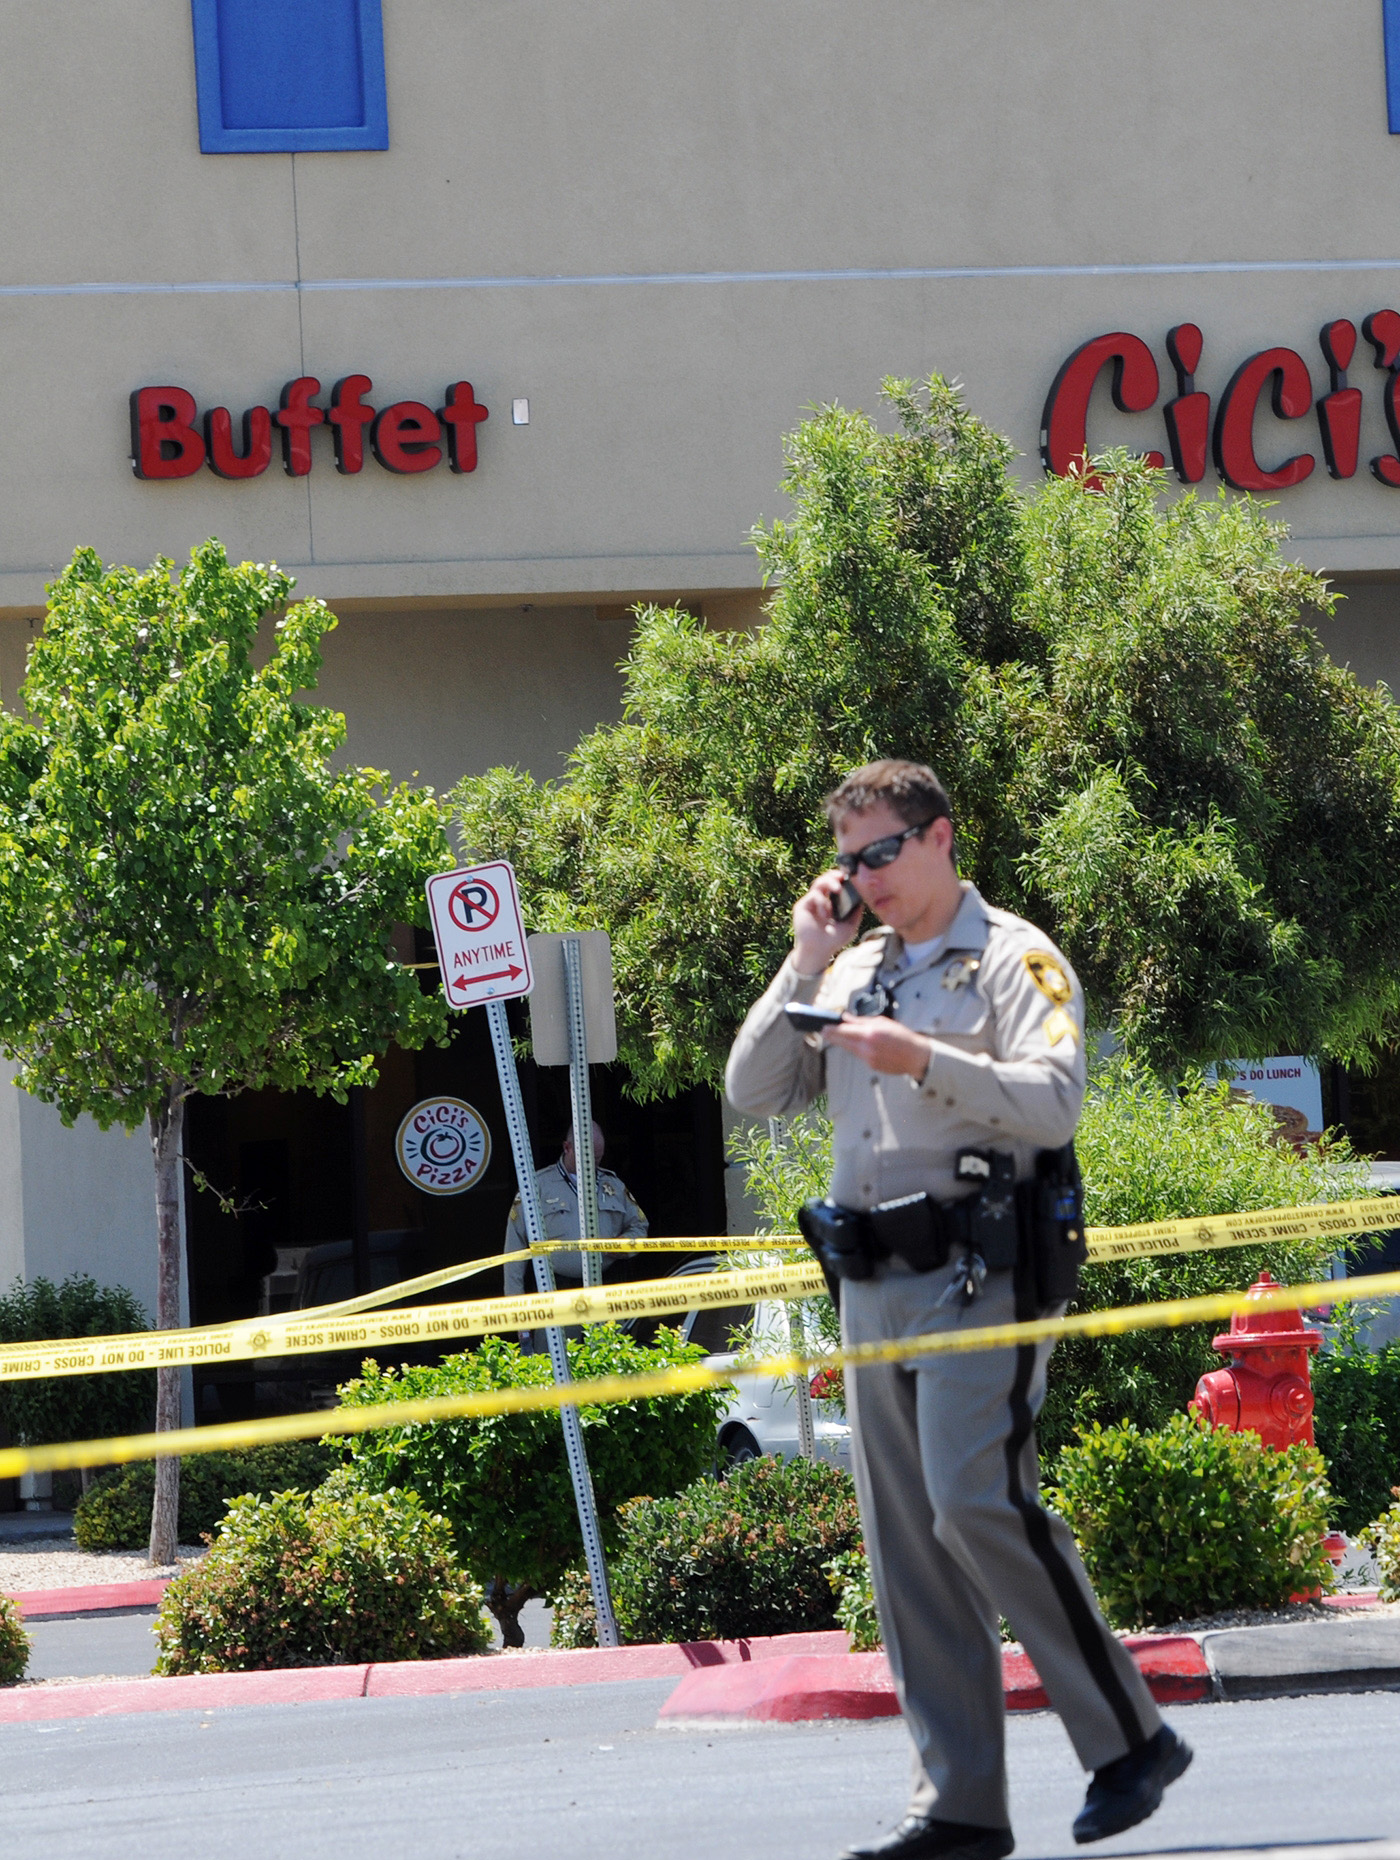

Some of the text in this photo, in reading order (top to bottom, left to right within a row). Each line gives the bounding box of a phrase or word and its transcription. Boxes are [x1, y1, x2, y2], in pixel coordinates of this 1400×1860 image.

[130, 374, 488, 479] Buffet
[454, 941, 515, 969] ANYTIME
[1250, 1070, 1264, 1080] DO
[1266, 1068, 1301, 1079] LUNCH
[1359, 1202, 1394, 1213] 385-5555
[1225, 1208, 1344, 1227] WWW.CRIMESTOPPERSOFNV.COM
[1318, 1218, 1355, 1231] CROSS
[1361, 1214, 1384, 1227] NOT
[1092, 1226, 1177, 1243] CRIME STOPPERS (702)
[1229, 1227, 1266, 1240] SCENE
[1269, 1223, 1305, 1236] CRIME
[1109, 1238, 1179, 1255] POLICE LINE
[607, 1279, 825, 1313] LINE DO NOT CROSS CRIME SCENE
[286, 1309, 554, 1347] POLICE LINE DO NOT CROSS CRIME SCENE
[129, 1350, 144, 1363] DO
[159, 1347, 184, 1361] LINE
[189, 1342, 231, 1359] POLICE
[54, 1354, 94, 1369] CROSS
[101, 1352, 124, 1365] NOT
[2, 1360, 41, 1373] CRIME
